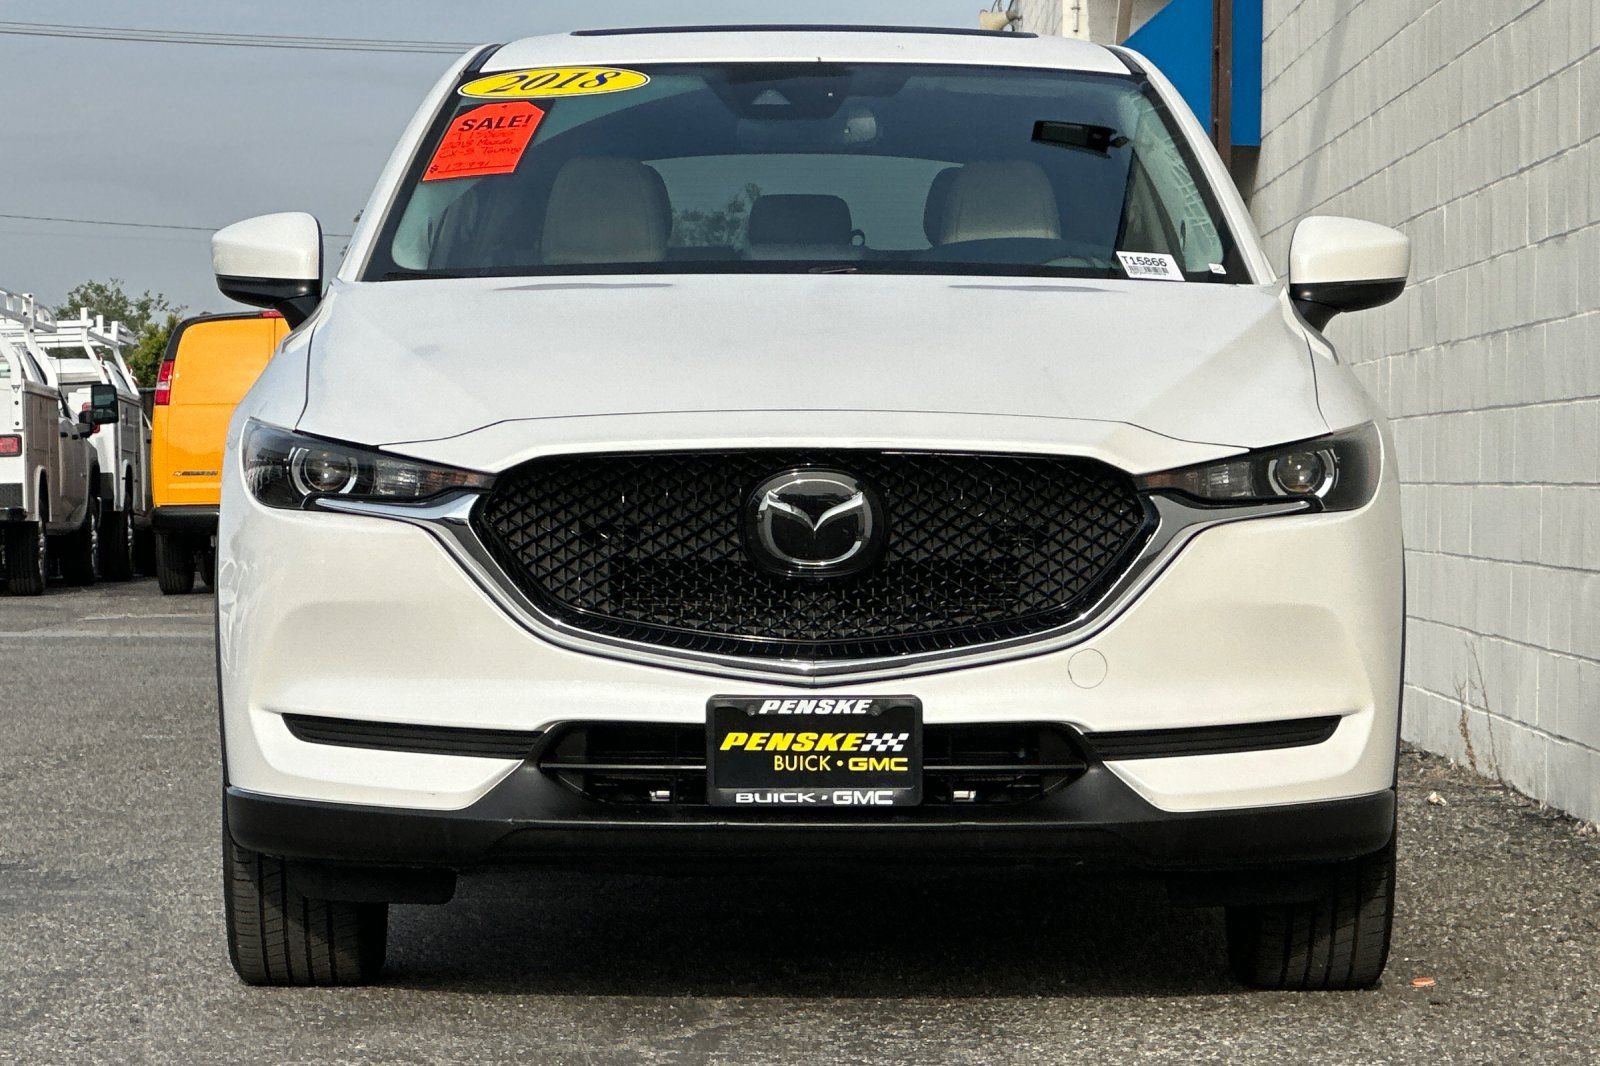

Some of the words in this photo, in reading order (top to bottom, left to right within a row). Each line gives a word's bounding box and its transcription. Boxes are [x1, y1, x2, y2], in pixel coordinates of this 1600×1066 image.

[484, 71, 621, 93] 2018
[459, 114, 532, 131] SALE!
[1121, 255, 1167, 267] T15866
[758, 699, 873, 714] PENSKE
[720, 732, 866, 751] PENSKE
[773, 755, 832, 771] BUICK
[848, 757, 908, 771] GMC
[735, 792, 817, 803] BUICK
[832, 790, 894, 805] GMC
